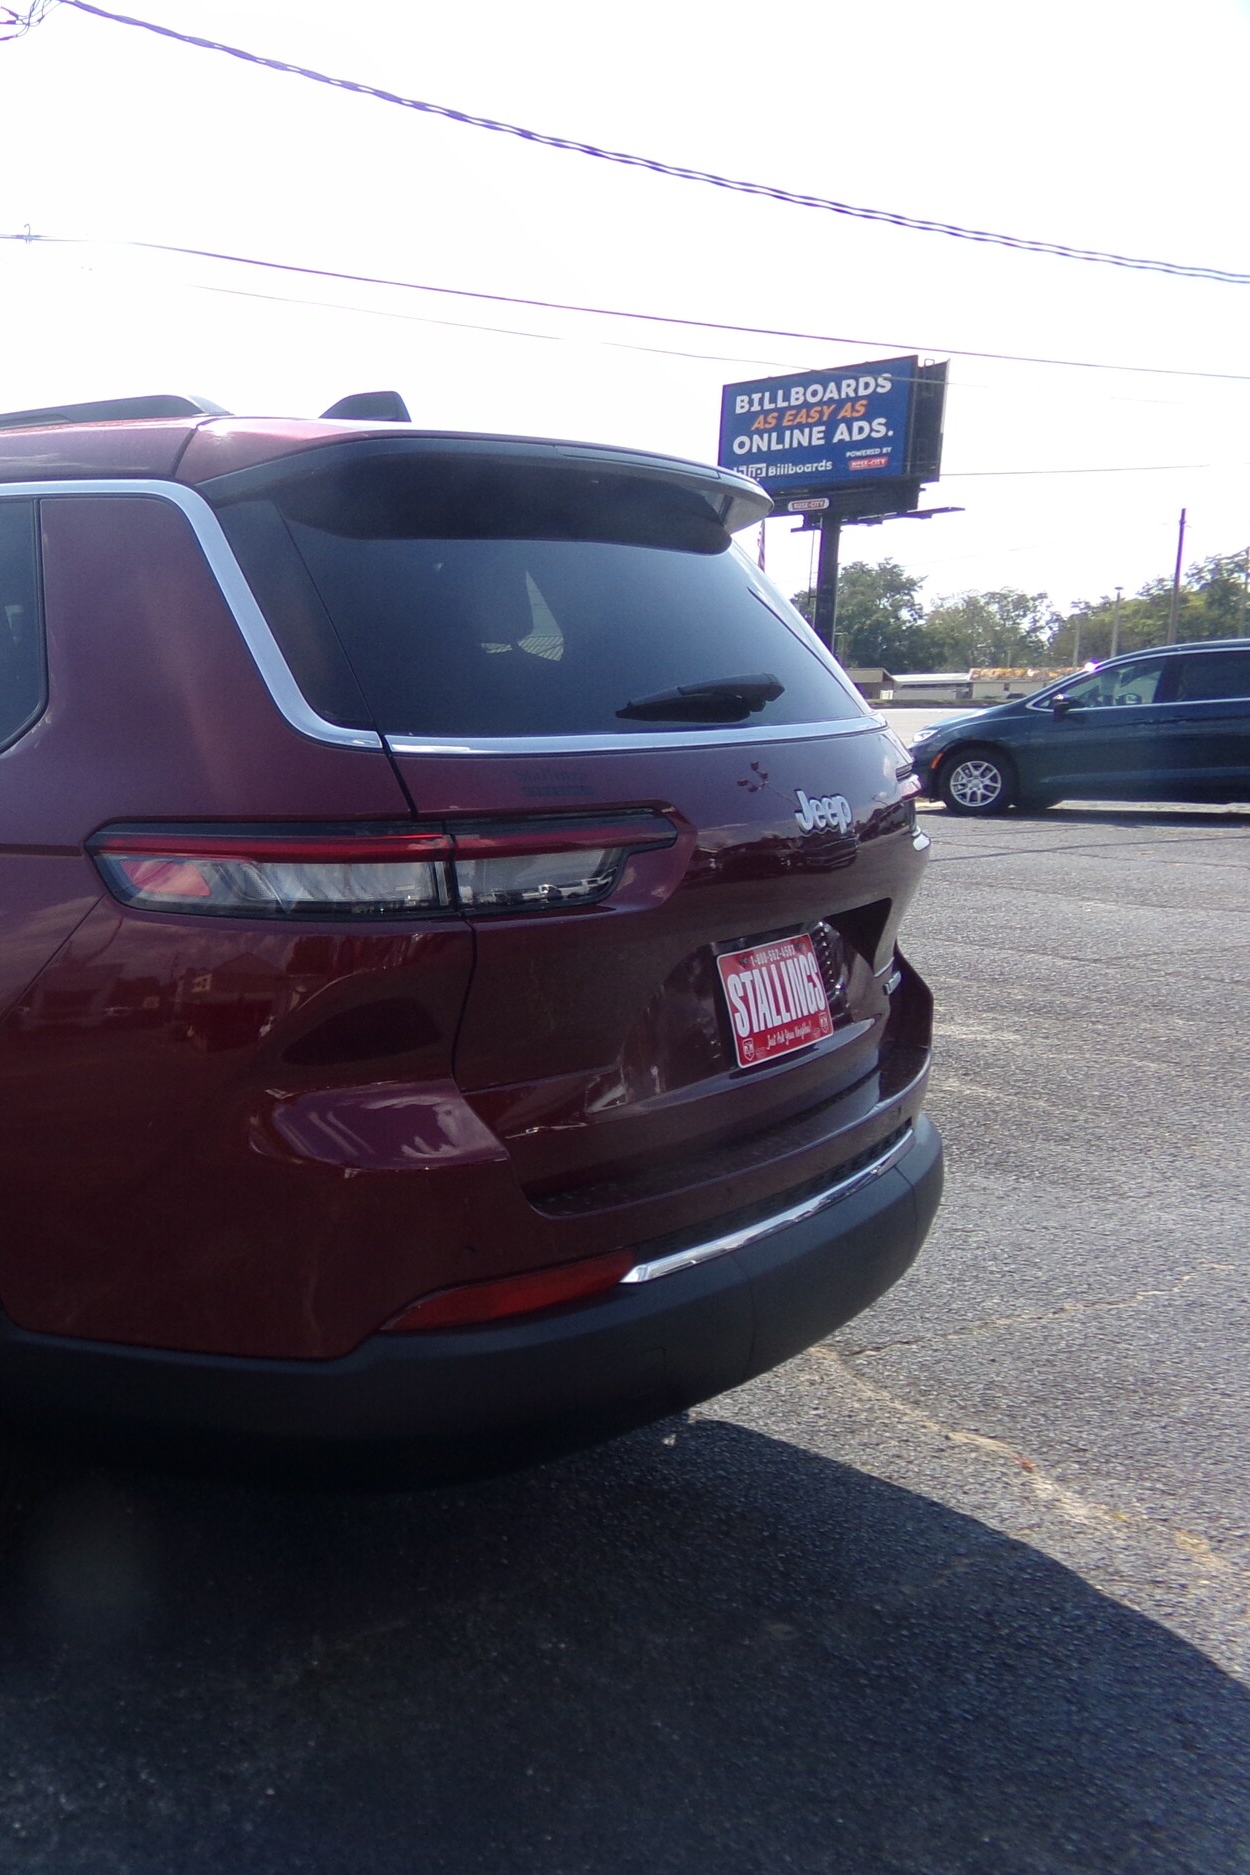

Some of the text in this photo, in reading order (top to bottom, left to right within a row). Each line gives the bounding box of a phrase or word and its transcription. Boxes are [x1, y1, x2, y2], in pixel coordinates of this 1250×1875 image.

[735, 373, 892, 414] BILLBOARDS
[751, 400, 868, 431] AS EASY AS
[733, 417, 894, 454] ONLINE ADS.
[845, 446, 892, 458] POWERED BY
[768, 460, 832, 476] Billboards
[794, 788, 852, 834] Jeep
[727, 952, 825, 1037] STALLINGS
